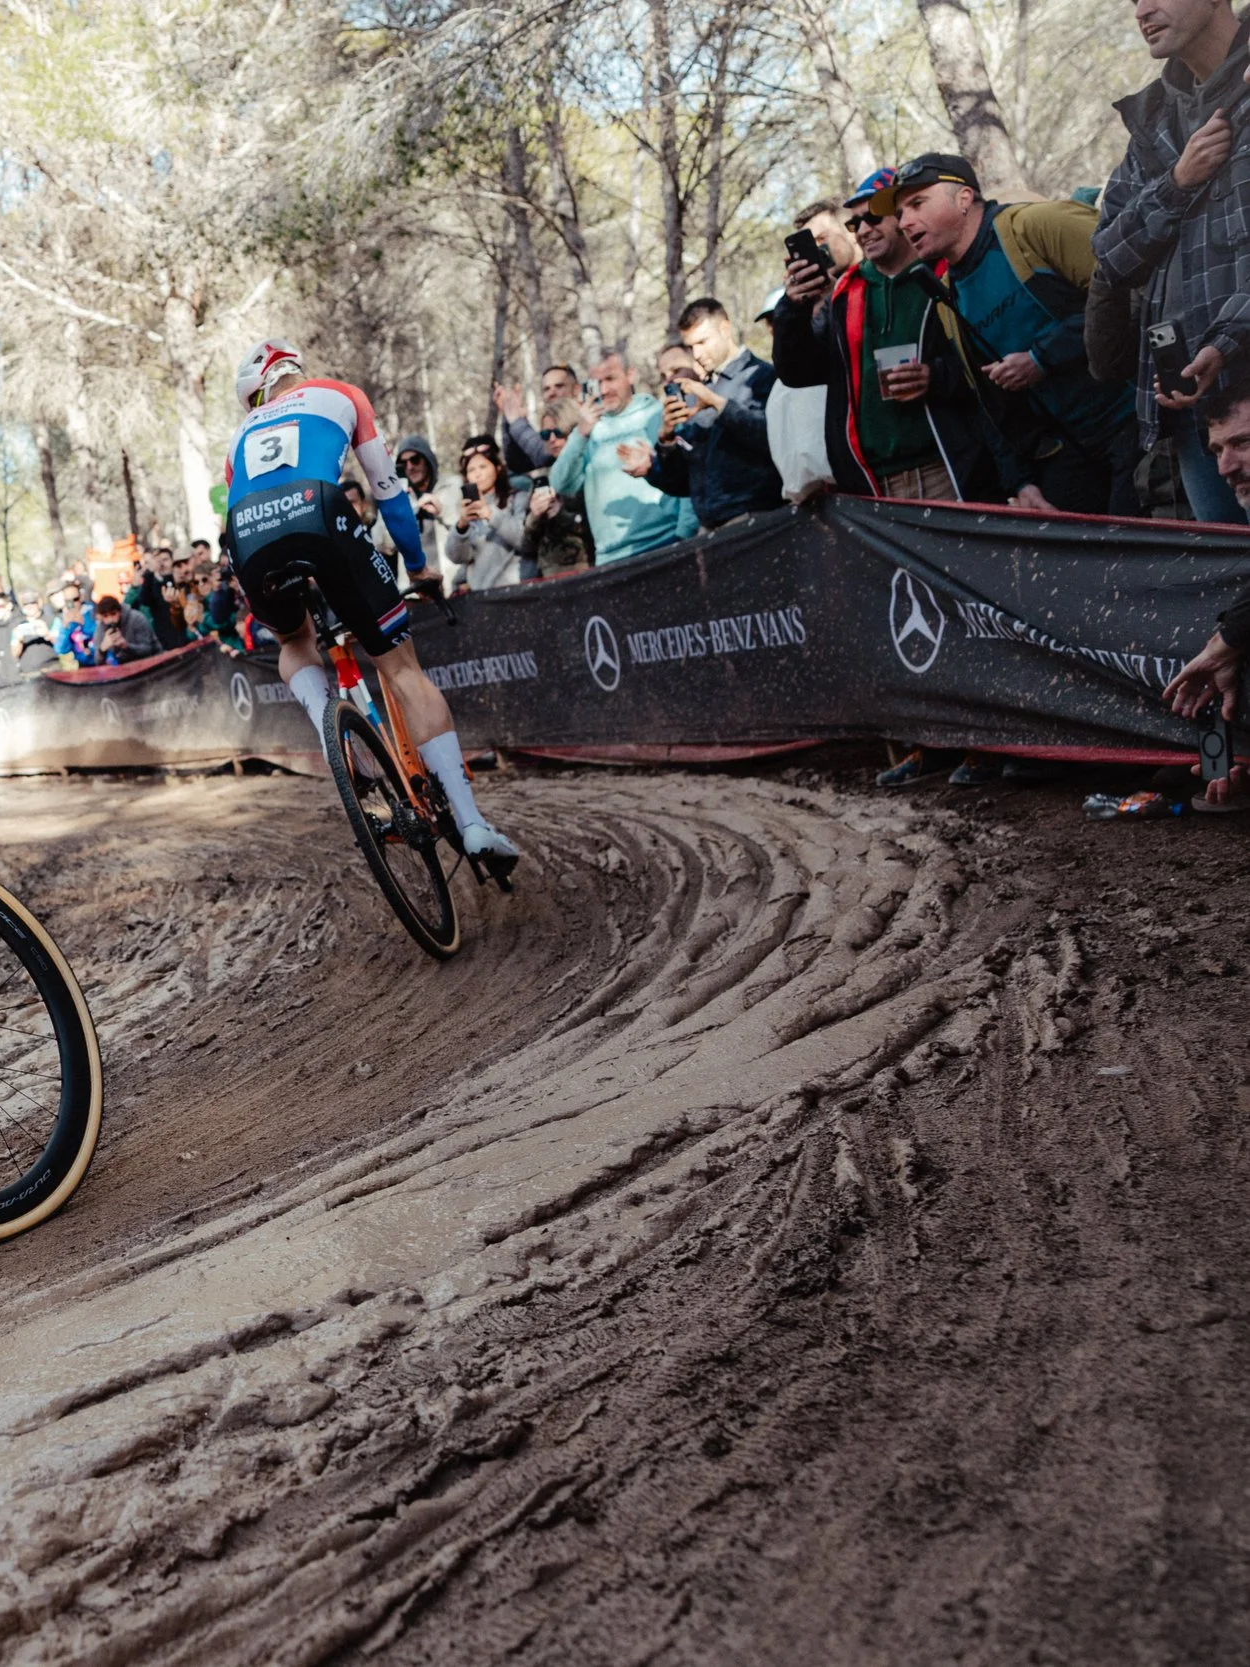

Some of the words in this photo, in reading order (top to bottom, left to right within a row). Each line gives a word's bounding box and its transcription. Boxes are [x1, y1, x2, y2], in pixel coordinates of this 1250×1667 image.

[260, 436, 283, 462] 3
[235, 491, 304, 528] BRUSTOR
[238, 526, 251, 539] sun
[257, 516, 282, 532] shade
[287, 504, 316, 521] shelter
[370, 551, 392, 584] TECH
[626, 614, 756, 665] MERCEDES-BENZ
[754, 606, 807, 648] VANS
